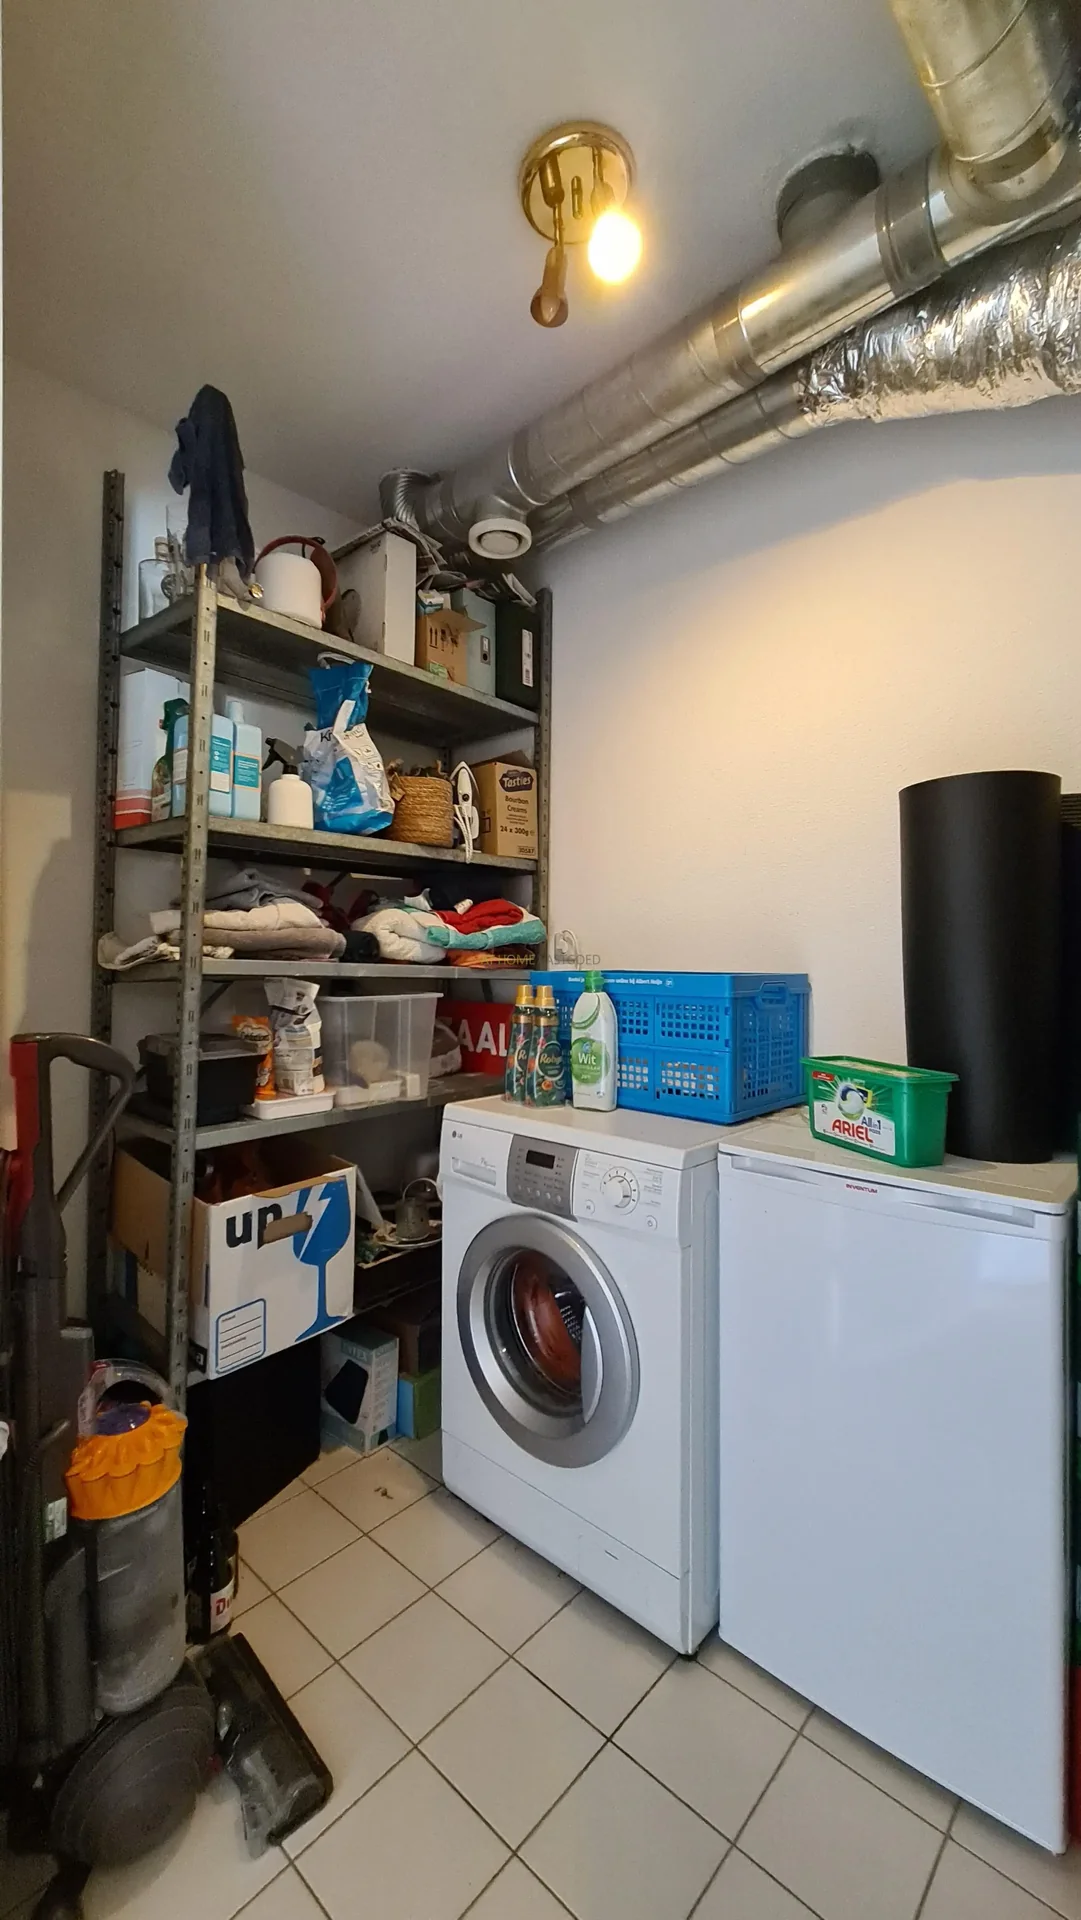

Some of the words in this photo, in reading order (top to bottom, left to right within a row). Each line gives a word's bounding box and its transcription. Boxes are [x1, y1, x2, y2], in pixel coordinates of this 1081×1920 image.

[502, 776, 532, 788] Tasties
[504, 795, 529, 805] Bourbon
[507, 805, 528, 814] Creams
[500, 825, 508, 833] 24
[514, 827, 529, 837] 300g
[578, 1052, 597, 1066] Wit
[832, 1119, 874, 1143] ARIEL
[846, 1184, 878, 1193] INVENTUM
